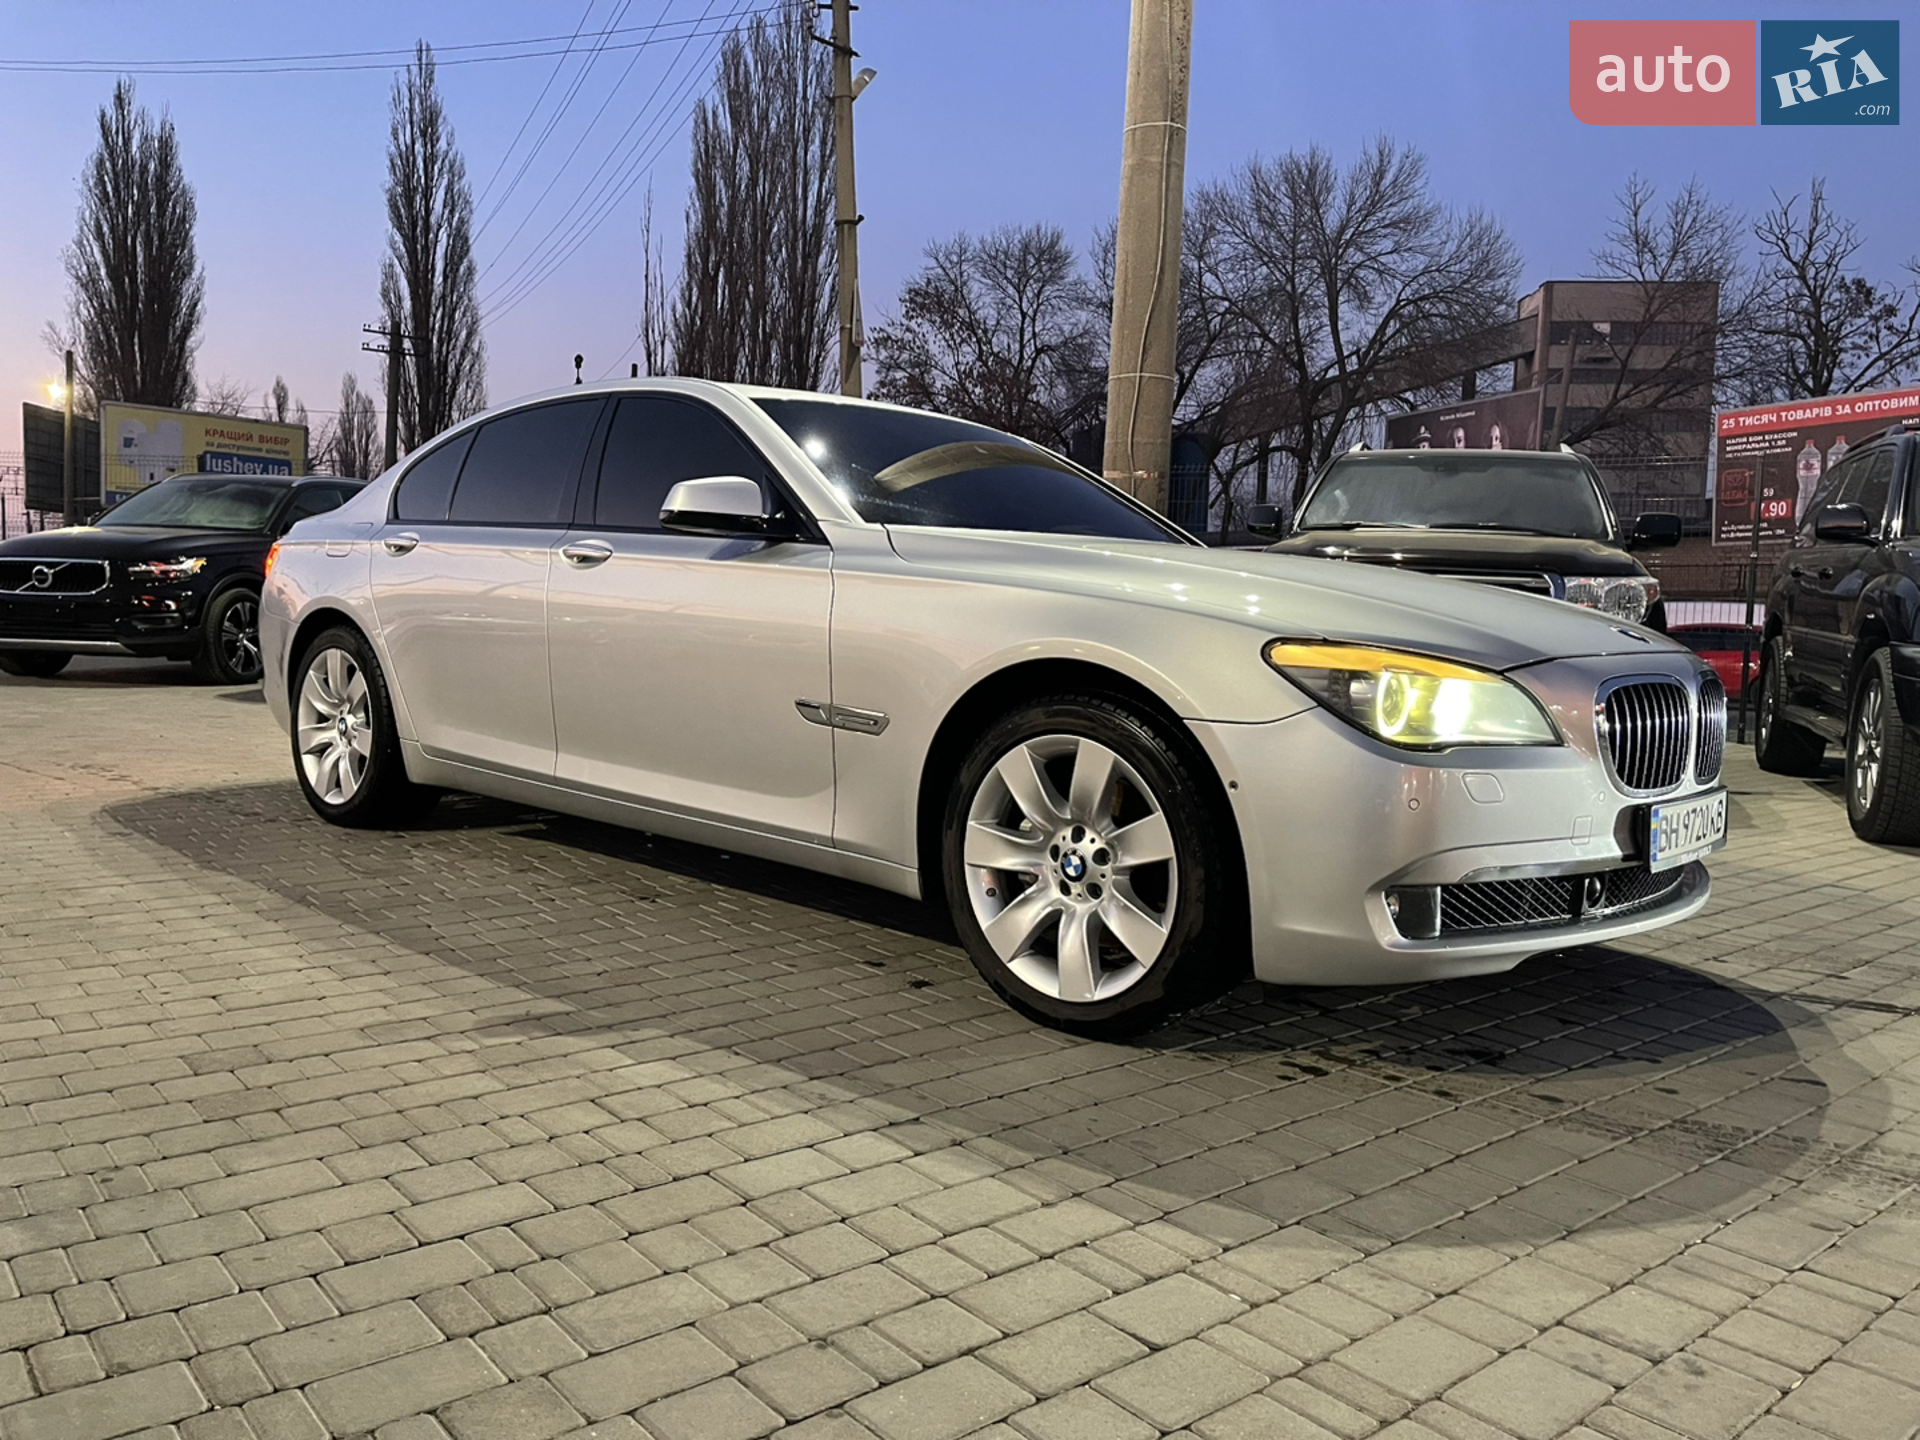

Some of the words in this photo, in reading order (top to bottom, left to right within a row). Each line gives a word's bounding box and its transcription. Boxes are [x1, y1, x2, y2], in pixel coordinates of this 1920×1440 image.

[1722, 419, 1735, 429] 25
[1738, 413, 1777, 427] ТИСЯЧ
[1780, 407, 1832, 422] ТОВАРІВ
[1836, 403, 1851, 415] ЗА
[1855, 395, 1919, 413] ОПТОВИМ
[205, 428, 253, 442] КРАЩИЙ
[258, 434, 290, 446] ВИБІР
[1659, 812, 1680, 852] BH
[1681, 804, 1709, 847] 9720
